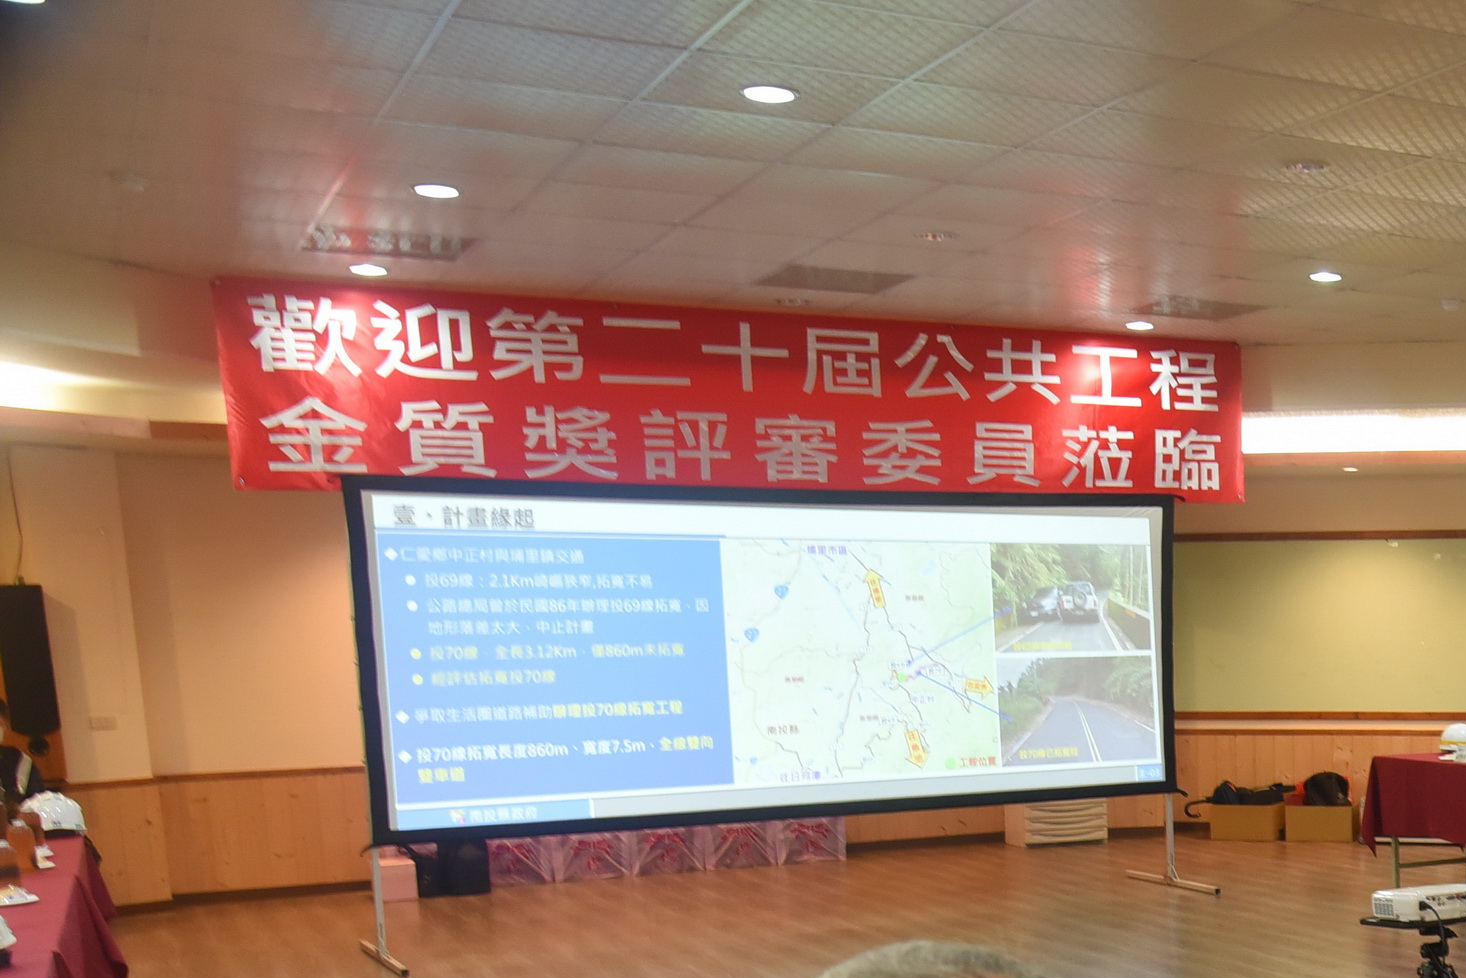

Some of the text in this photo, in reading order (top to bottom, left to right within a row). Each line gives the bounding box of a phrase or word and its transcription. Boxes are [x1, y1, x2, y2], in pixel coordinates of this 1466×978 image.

[247, 292, 1219, 413] 歡迎第二十屆公共工程
[258, 395, 1222, 494] 金質獎評審委員蒞臨
[393, 505, 535, 529] 壹、計畫緣起
